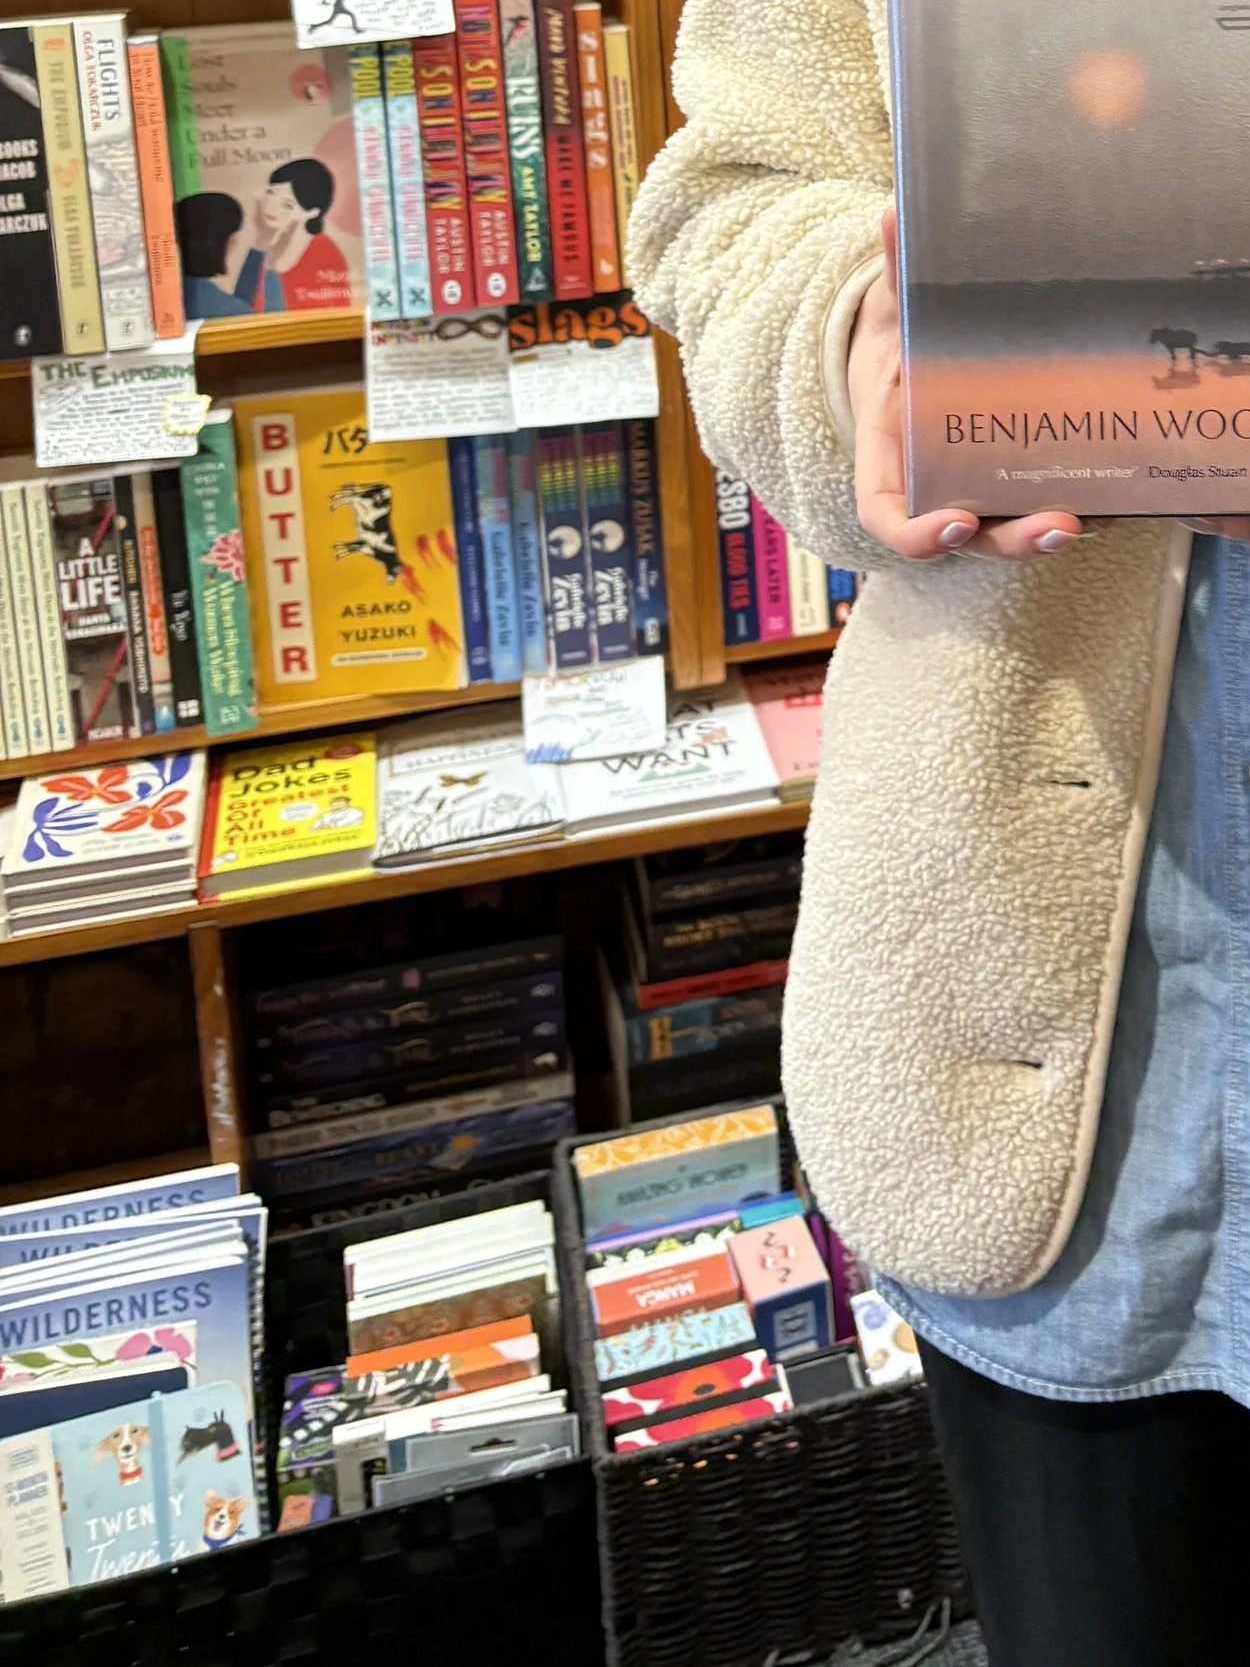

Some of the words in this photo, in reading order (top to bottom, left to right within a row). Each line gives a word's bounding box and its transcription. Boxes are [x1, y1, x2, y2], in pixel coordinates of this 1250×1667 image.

[98, 39, 120, 121] FLIGHTS
[524, 203, 541, 263] TAYLOR
[946, 410, 1138, 449] BENJAMIN
[1012, 466, 1090, 483] magnificent
[1149, 466, 1205, 482] Douglas
[1208, 465, 1247, 479] Stuart
[80, 537, 93, 557] A
[262, 423, 308, 674] BUTTER
[59, 555, 118, 581] LITTLE
[61, 576, 119, 612] LIFE
[341, 600, 411, 618] ASAKO
[341, 626, 416, 642] YUZUKI
[231, 756, 316, 782] Dad
[603, 740, 737, 773] WANT
[229, 768, 352, 799] Jokes
[228, 784, 349, 810] Greatest
[225, 819, 263, 834] All
[227, 807, 260, 823] Of
[223, 828, 296, 845] Time
[0, 1282, 213, 1349] WILDERNESS
